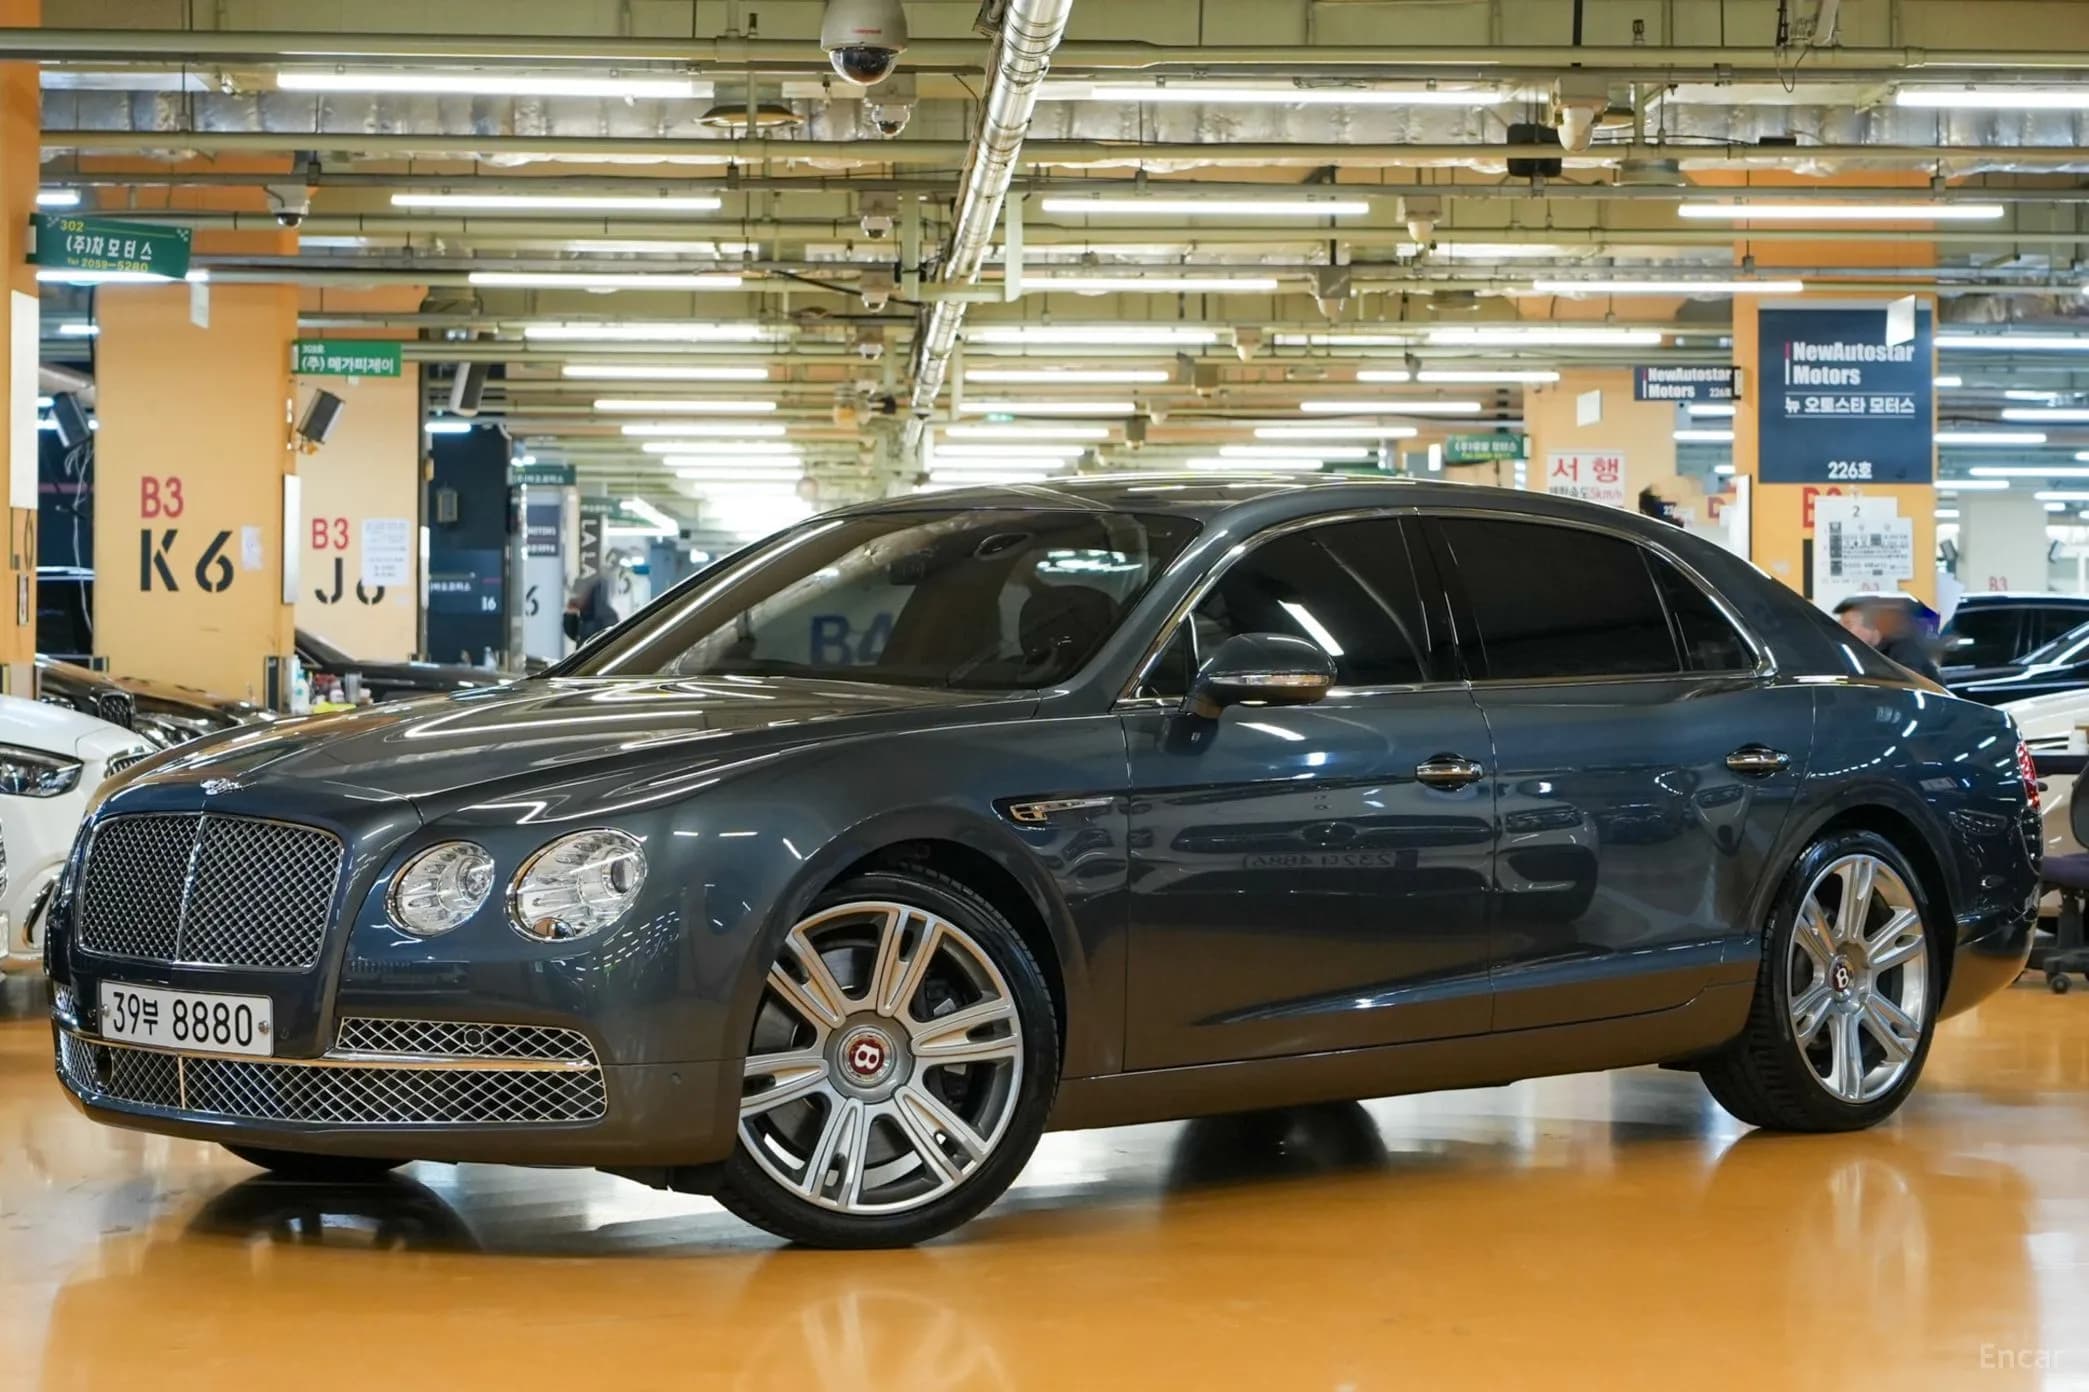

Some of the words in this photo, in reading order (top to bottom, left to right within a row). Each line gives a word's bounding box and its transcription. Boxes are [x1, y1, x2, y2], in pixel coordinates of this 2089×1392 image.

[60, 219, 85, 232] 302
[1793, 341, 1915, 362] NewAutostar
[1648, 367, 1733, 382] NewAutostar
[1793, 364, 1861, 385] Motors
[1648, 383, 1696, 399] Motors
[1785, 396, 1800, 413] 뉴
[1804, 396, 1866, 413] 오토스타
[1869, 396, 1915, 413] 모터스
[1827, 461, 1873, 479] 226호
[140, 476, 184, 518] B3
[312, 518, 350, 550] B3
[112, 991, 159, 1036] 39부
[172, 999, 253, 1047] 8880
